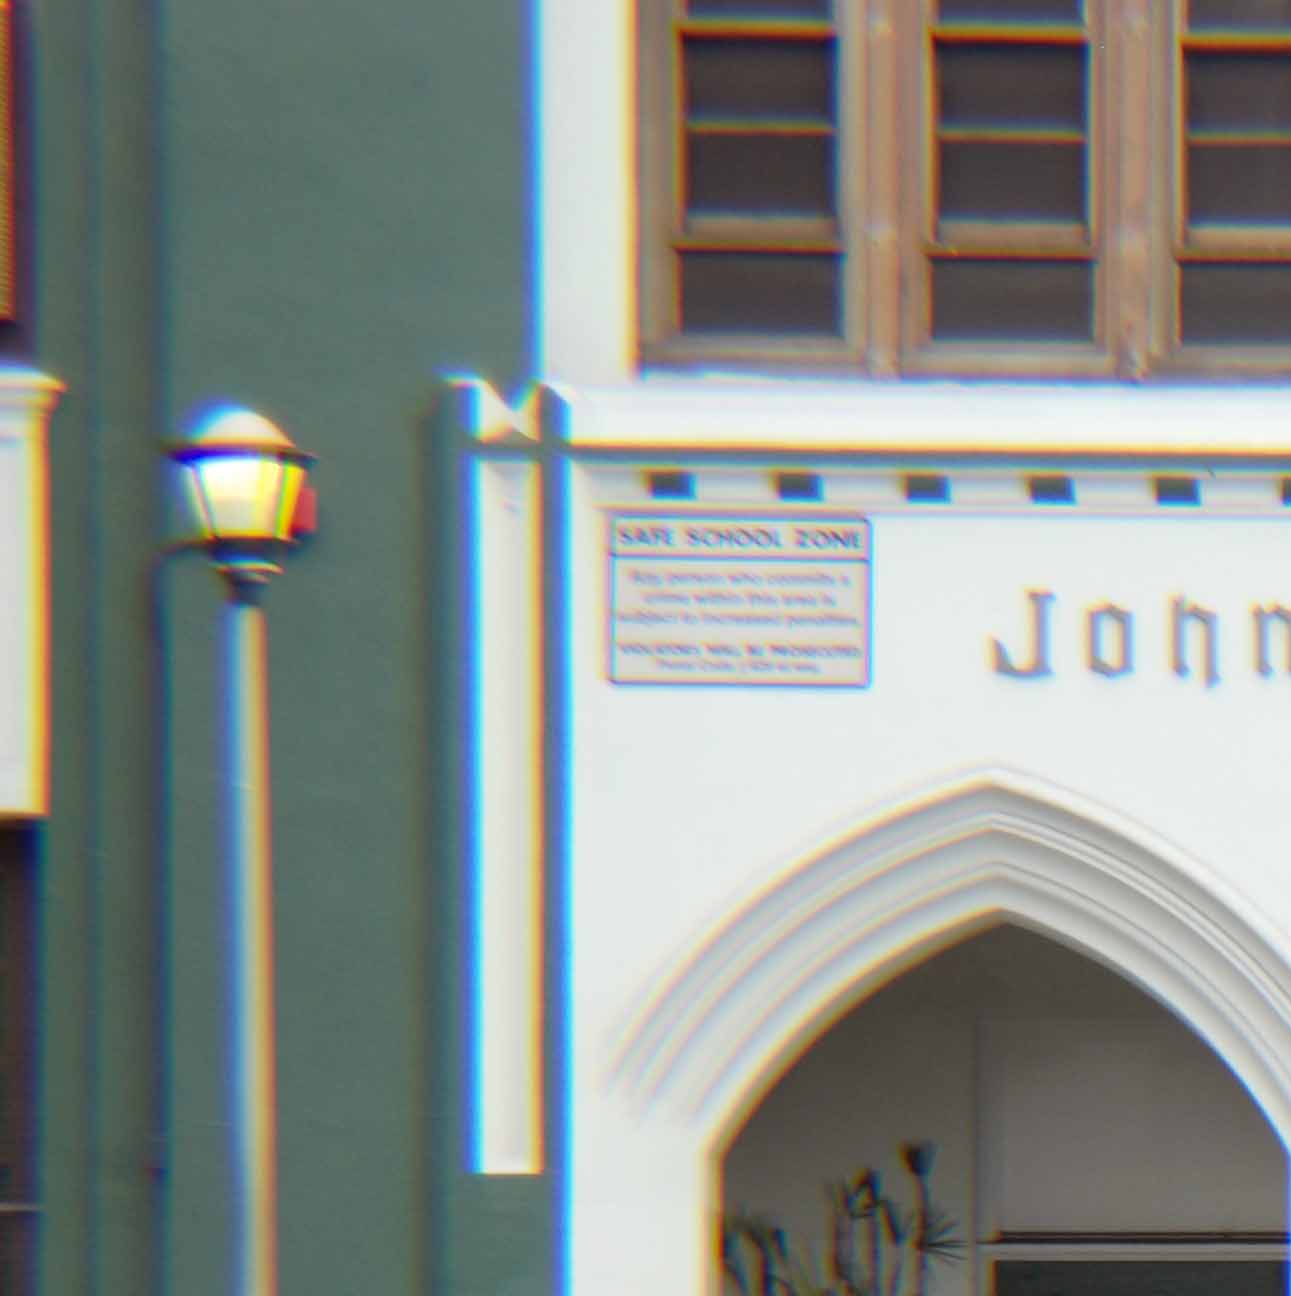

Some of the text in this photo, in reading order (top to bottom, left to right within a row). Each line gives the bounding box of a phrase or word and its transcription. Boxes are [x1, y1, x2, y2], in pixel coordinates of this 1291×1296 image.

[617, 528, 864, 549] SAFE SCHOOL ZONE
